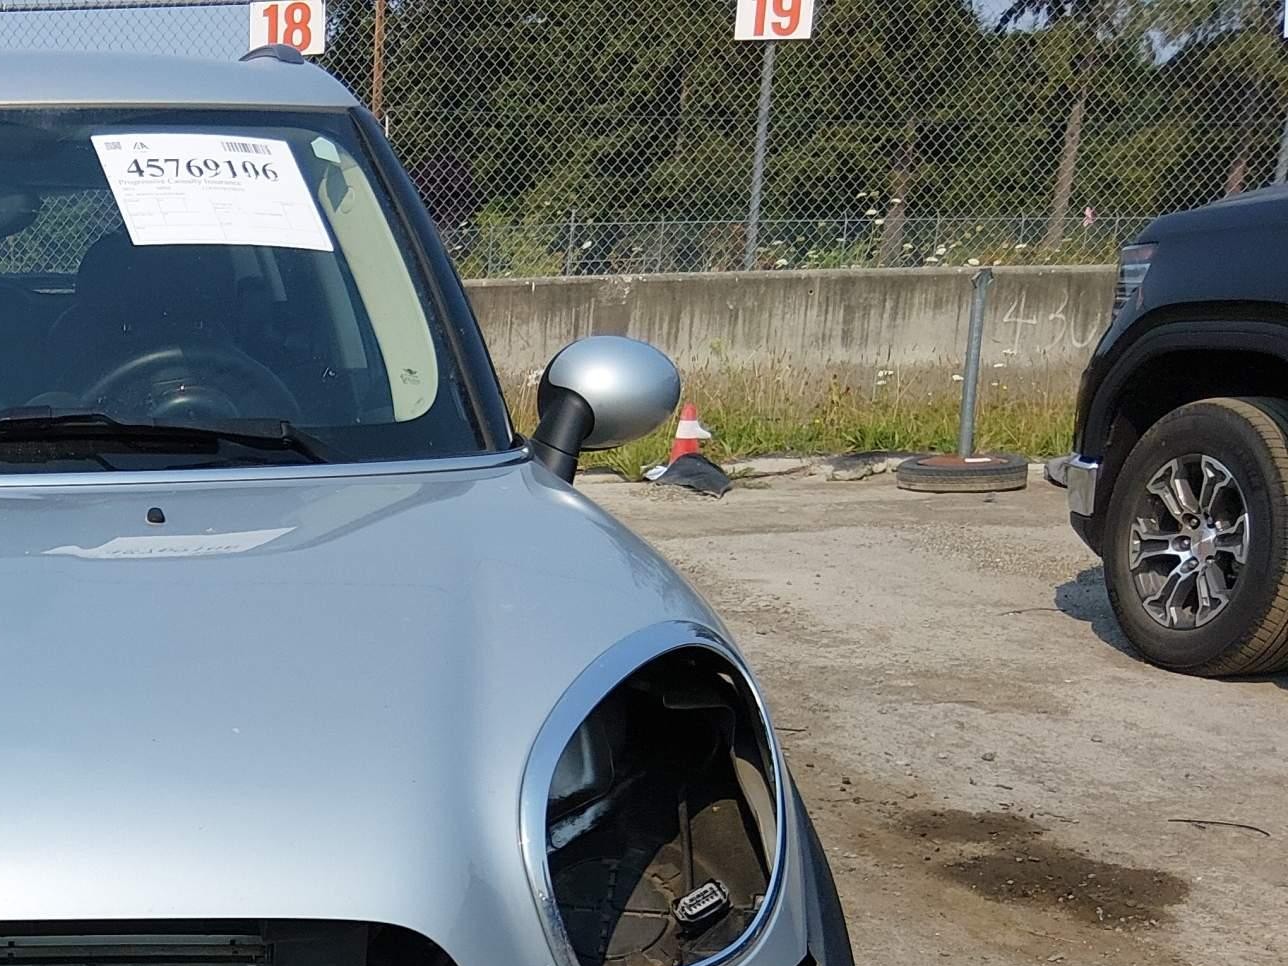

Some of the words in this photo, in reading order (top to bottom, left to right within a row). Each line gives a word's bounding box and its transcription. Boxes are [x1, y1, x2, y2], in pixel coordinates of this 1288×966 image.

[262, 2, 312, 52] 18
[753, 0, 802, 36] 19
[126, 158, 279, 182] 45769106
